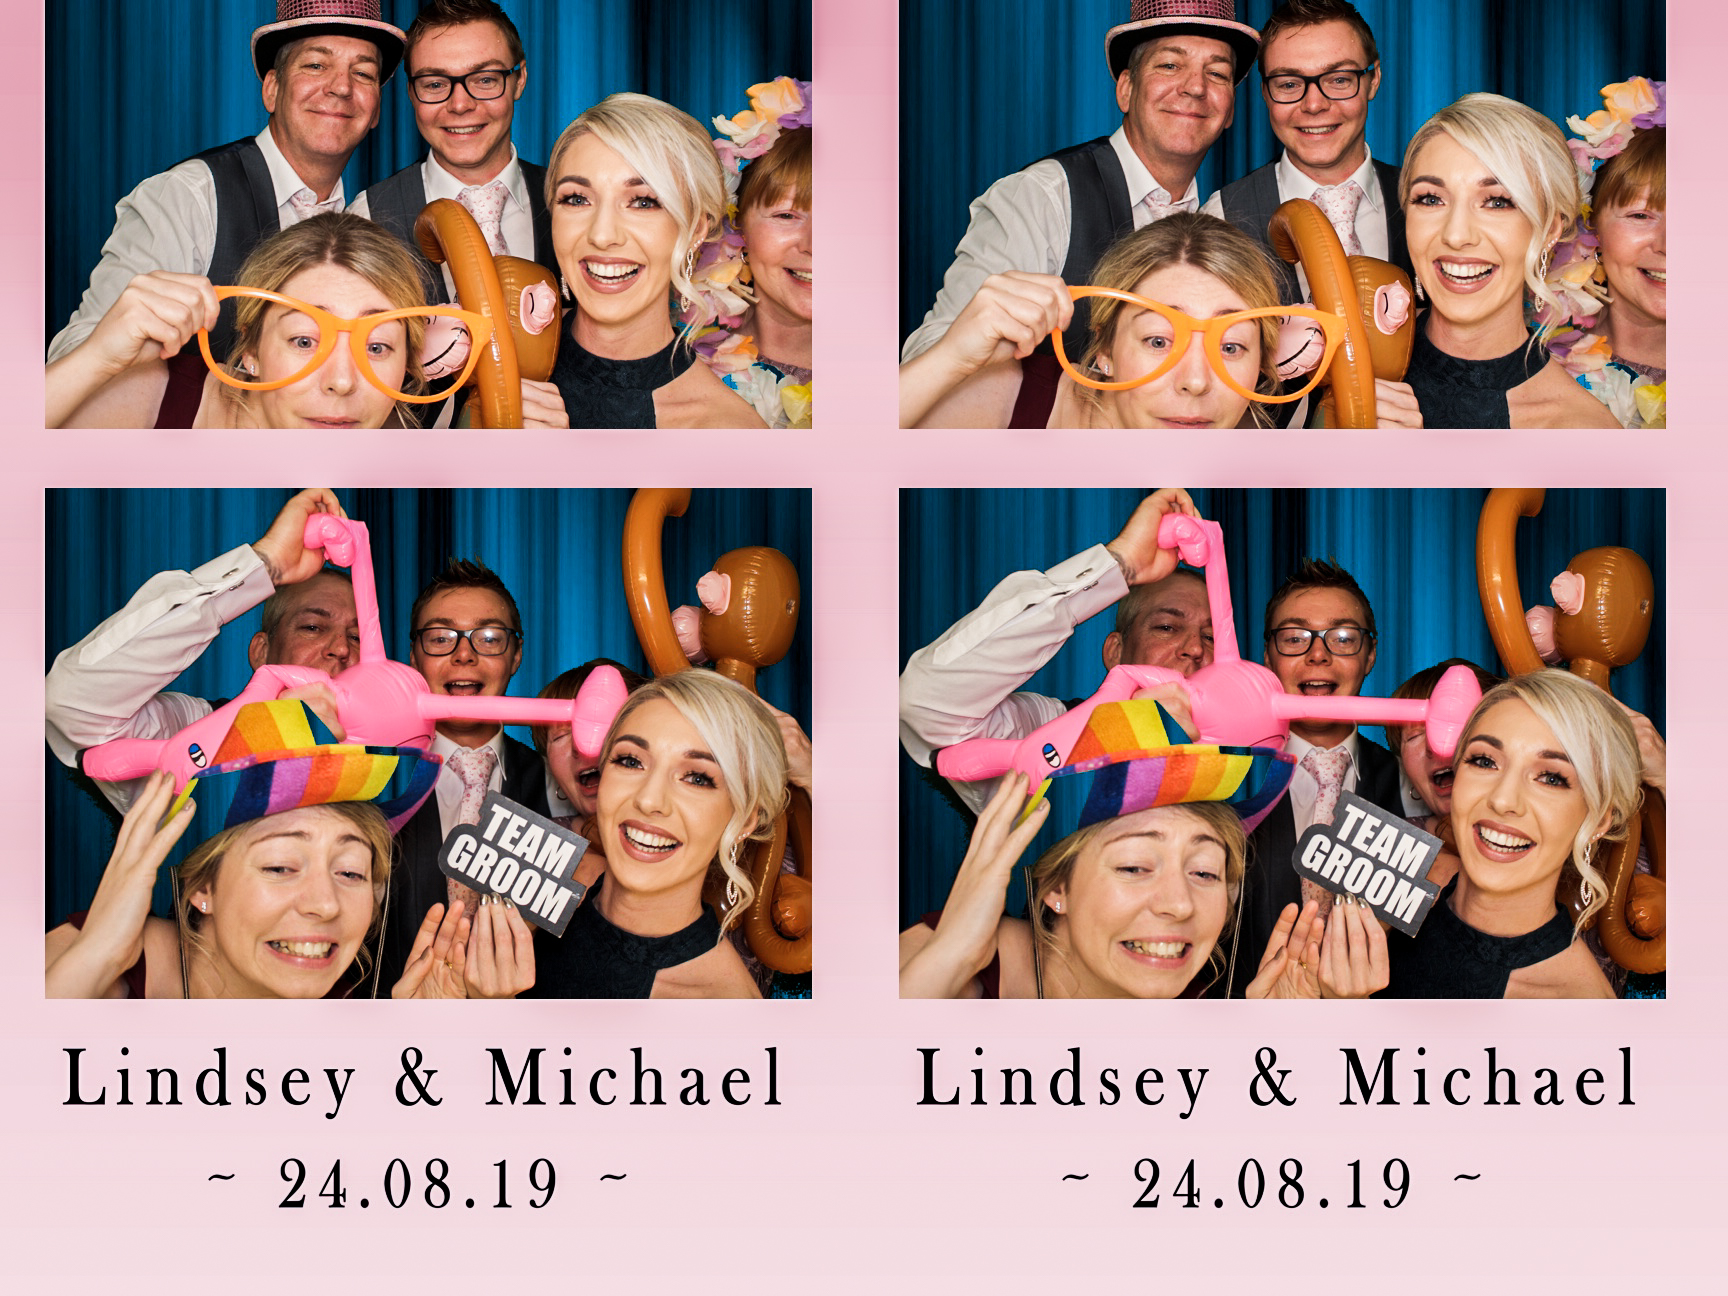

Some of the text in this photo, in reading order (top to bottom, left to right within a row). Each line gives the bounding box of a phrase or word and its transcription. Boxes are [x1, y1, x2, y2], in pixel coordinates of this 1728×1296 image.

[447, 834, 573, 924] GROOM
[483, 804, 576, 879] TEAM
[1301, 834, 1427, 924] GROOM
[1337, 804, 1430, 879] TEAM
